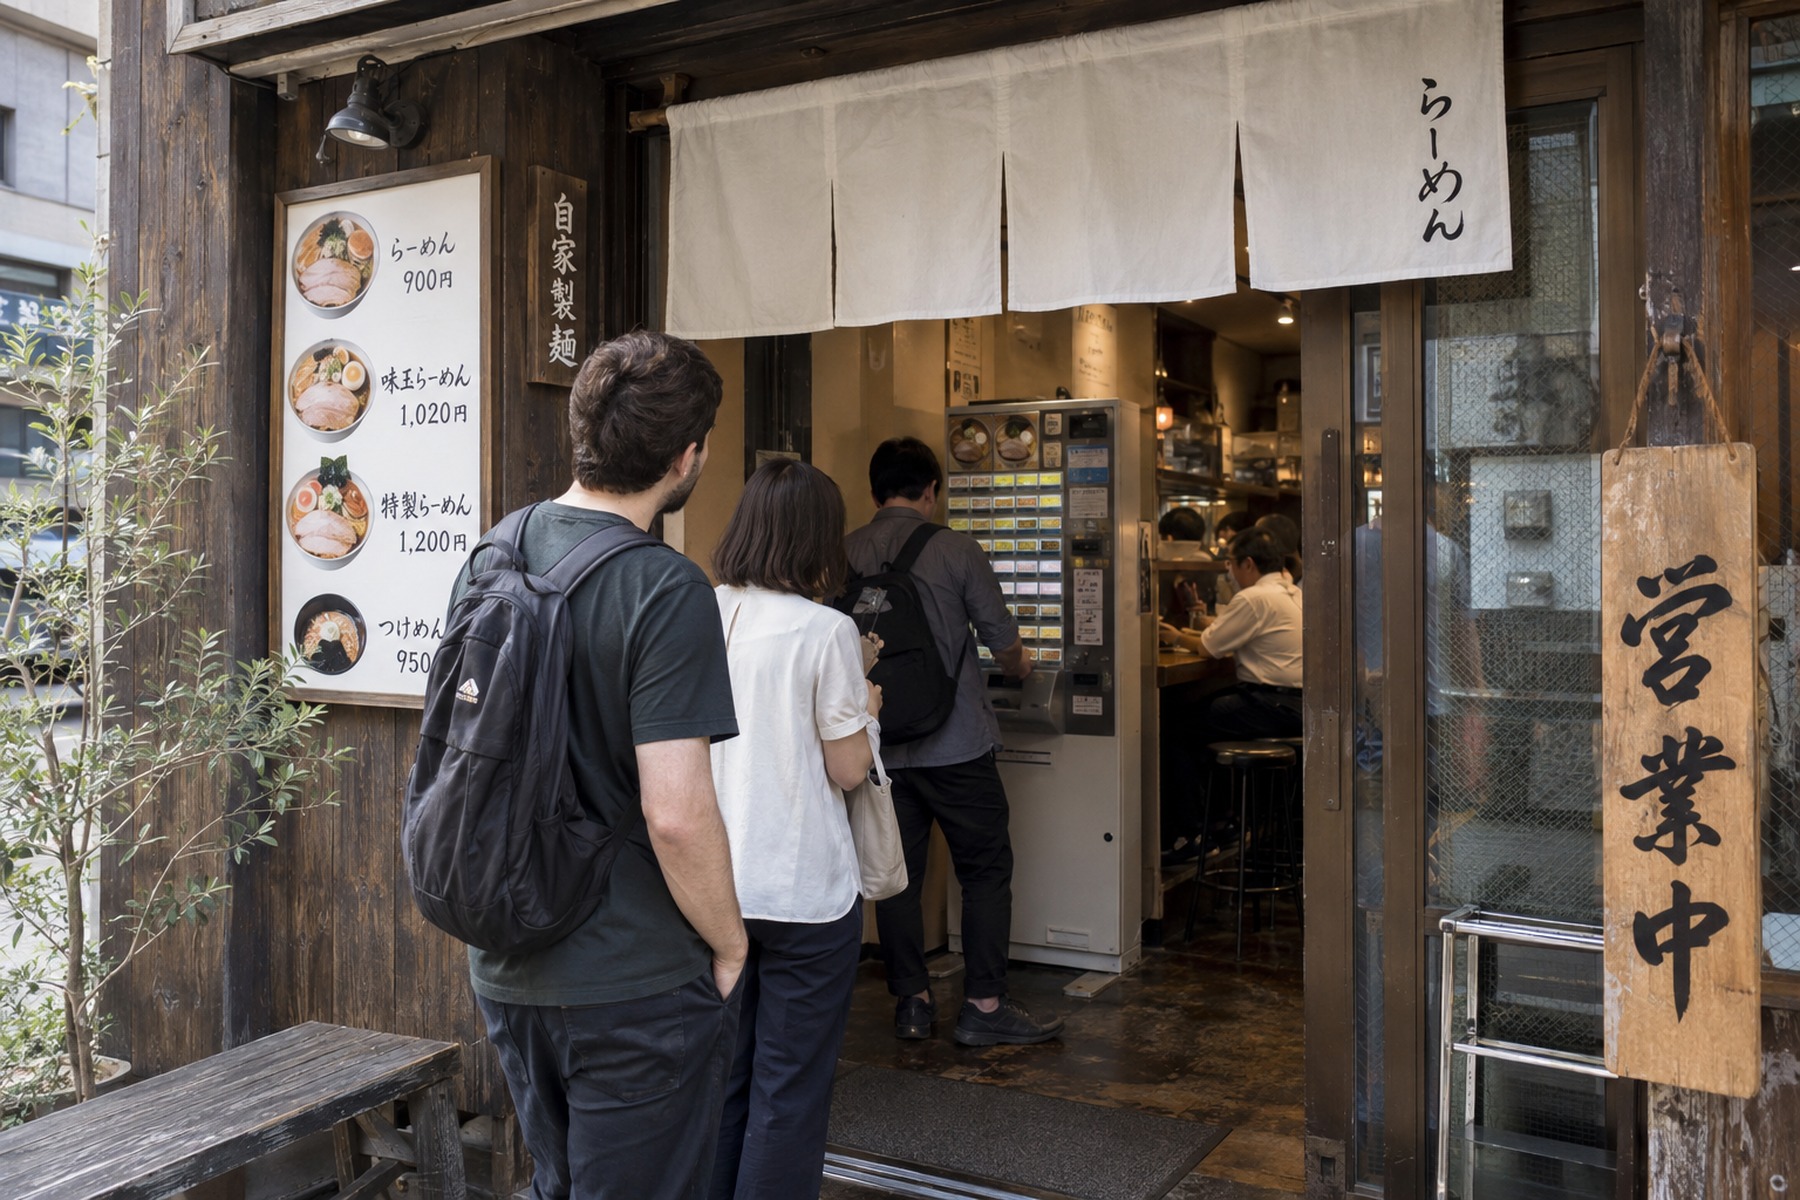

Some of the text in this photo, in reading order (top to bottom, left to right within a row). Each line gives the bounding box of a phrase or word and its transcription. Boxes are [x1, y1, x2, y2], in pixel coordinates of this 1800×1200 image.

[1418, 77, 1465, 243] らーめん
[391, 231, 456, 262] らーめん
[403, 268, 453, 294] 900円
[548, 192, 579, 369] 自家製麺
[380, 363, 472, 395] 味玉らーめん
[400, 401, 467, 428] 1,020円
[380, 491, 472, 520] 特製らーめん
[399, 530, 467, 556] 1,200円
[378, 616, 444, 640] つけめん
[1618, 553, 1737, 1025] 営業中
